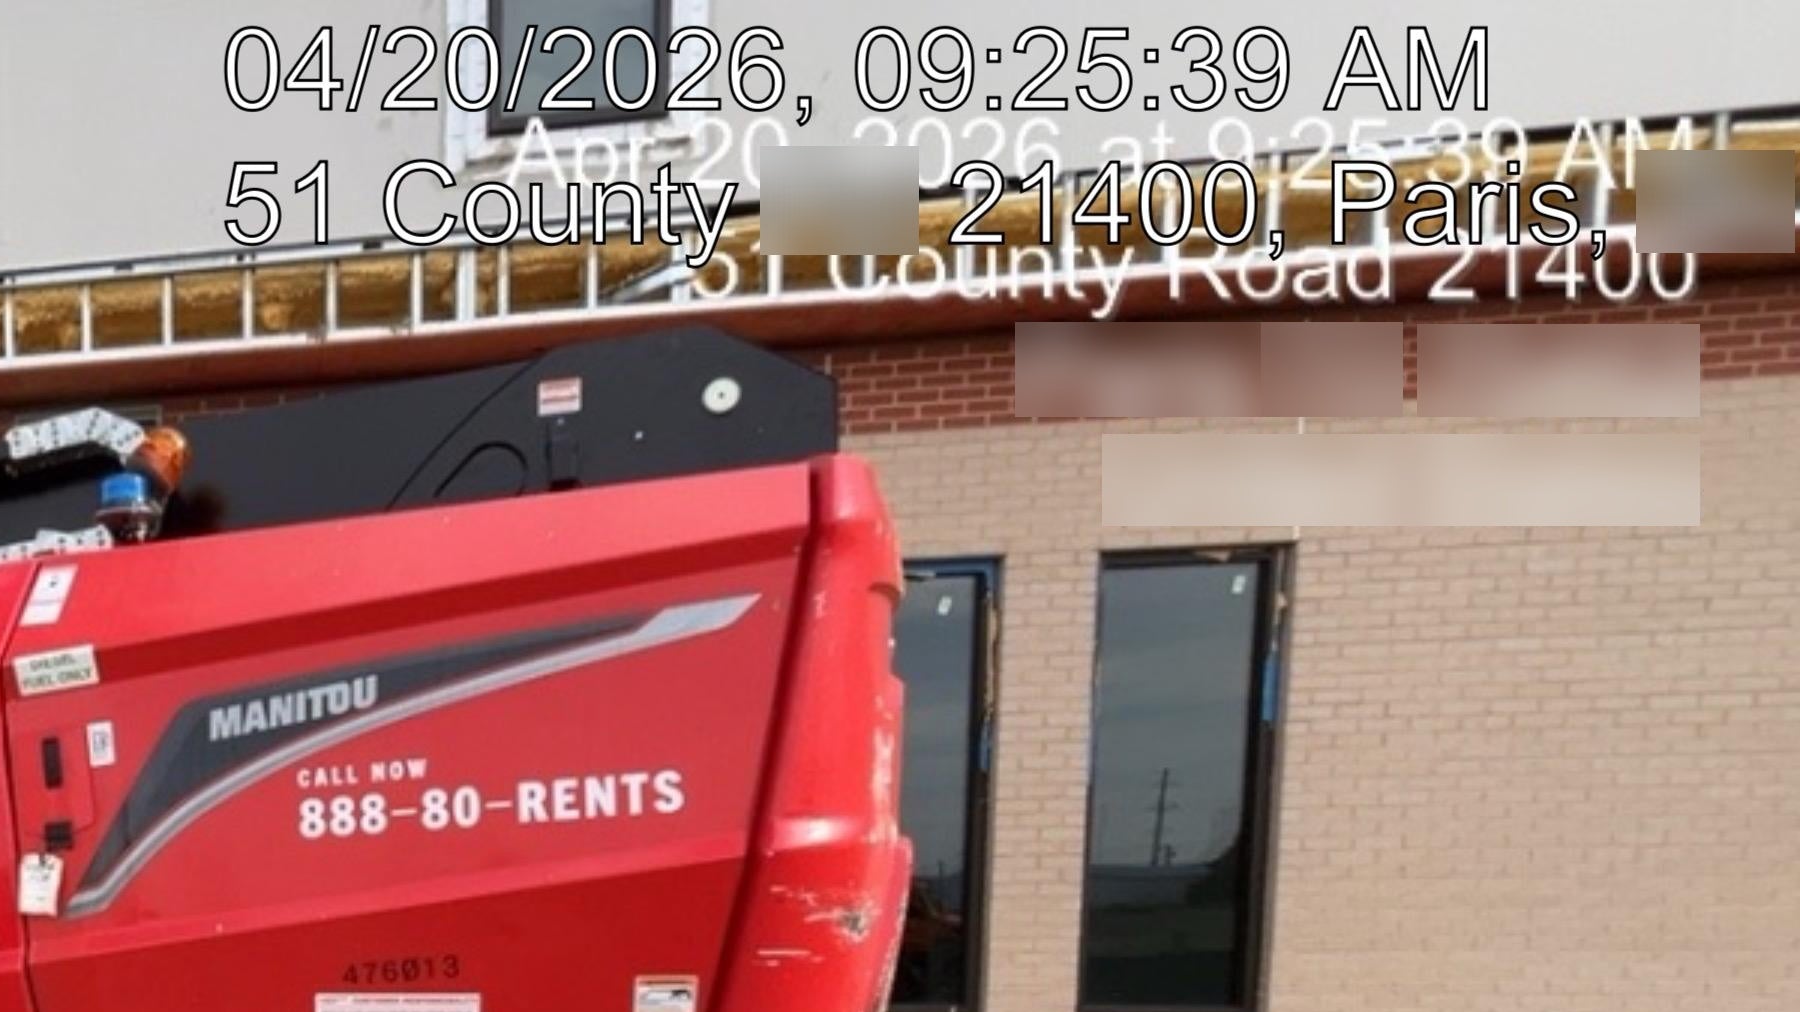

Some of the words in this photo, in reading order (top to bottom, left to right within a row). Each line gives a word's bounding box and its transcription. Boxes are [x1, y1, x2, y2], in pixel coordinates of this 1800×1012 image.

[209, 675, 379, 742] MANITOU
[297, 764, 359, 788] CALL
[371, 758, 428, 782] NOW
[299, 770, 685, 838] 888-80-RENTS
[342, 954, 461, 985] 476013
